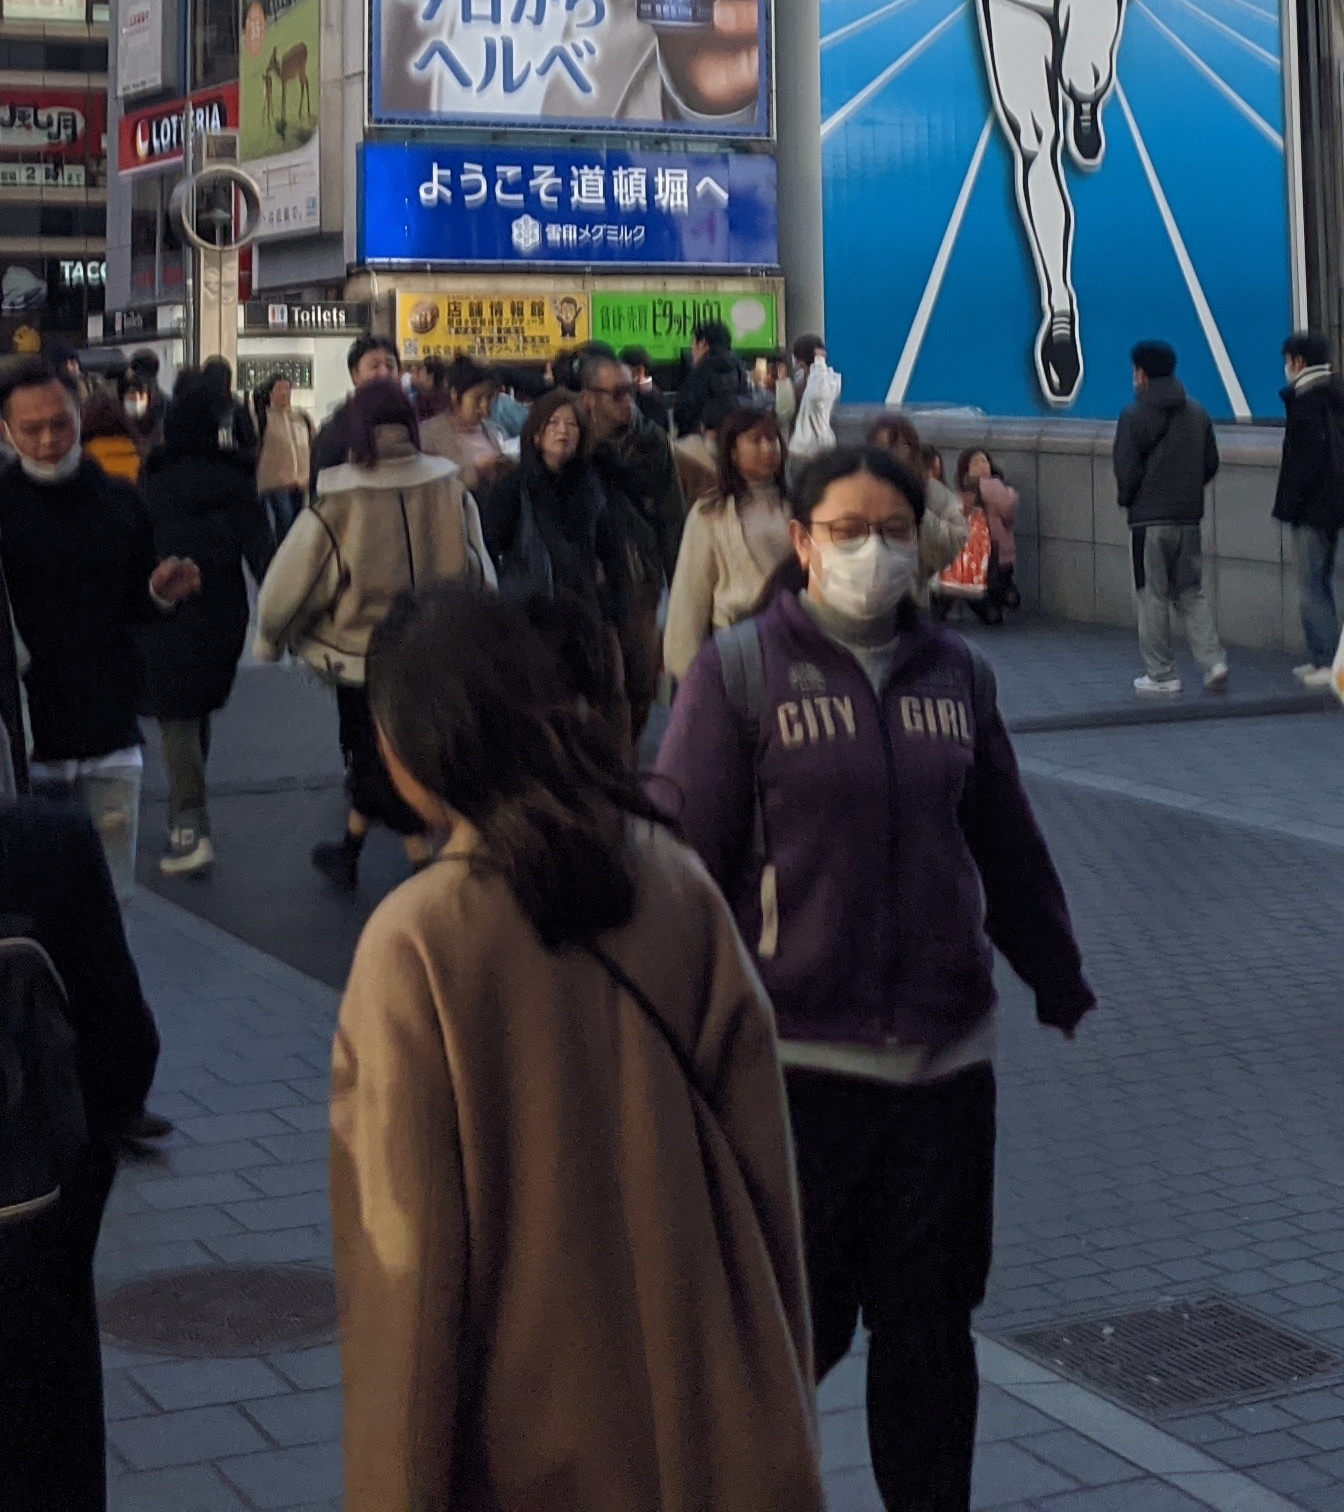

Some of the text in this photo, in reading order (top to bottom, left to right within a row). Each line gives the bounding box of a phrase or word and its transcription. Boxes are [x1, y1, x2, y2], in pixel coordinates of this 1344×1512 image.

[418, 161, 730, 211] ようこそ道頓堀へ
[545, 221, 646, 248] 雪印メグミルク
[291, 304, 346, 326] Toilets
[777, 694, 972, 750] CITY GIRL
